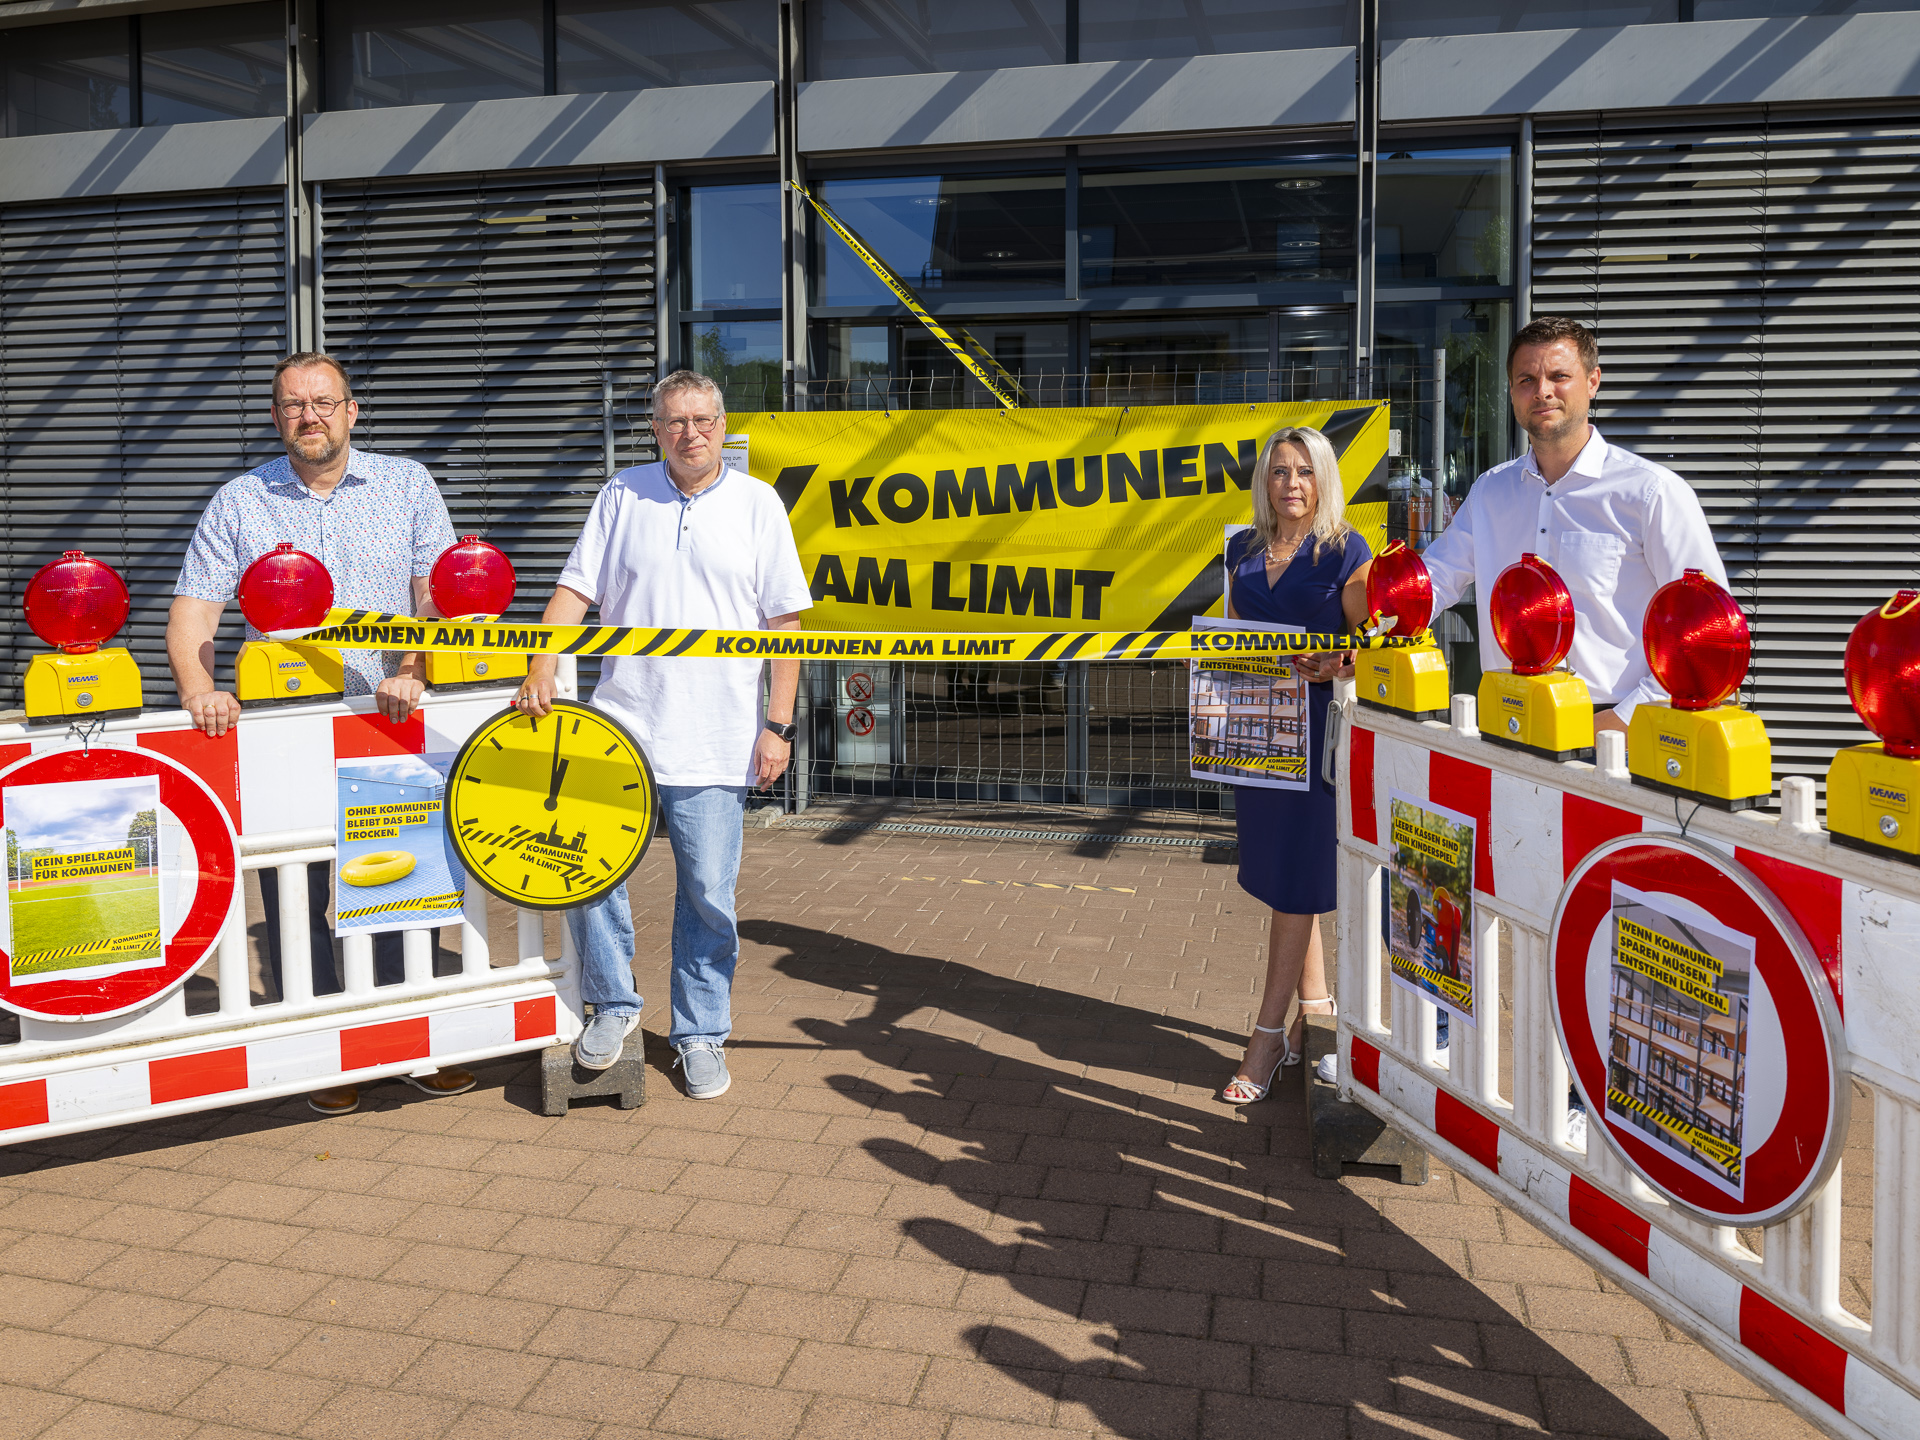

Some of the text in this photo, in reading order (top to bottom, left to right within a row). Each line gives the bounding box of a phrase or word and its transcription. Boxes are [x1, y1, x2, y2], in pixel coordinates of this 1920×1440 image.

[829, 438, 1258, 529] KOMMUNEN
[811, 553, 1115, 621] AM LIMIT
[431, 627, 475, 646] AM
[481, 629, 554, 649] LIMIT
[715, 636, 1016, 655] KOMMUNEN AM LIMIT
[1190, 633, 1370, 651] KOMMUNEN
[1200, 661, 1289, 677] ENTSTEHEN LÜCKEN.
[68, 675, 99, 683] WEMAS
[1659, 733, 1687, 748] WEMAS
[1869, 786, 1906, 803] WEMAS
[347, 801, 440, 816] OHNE KOMMUNEN
[347, 814, 426, 828] BLEIBT DAS BAD
[347, 828, 398, 840] TROCKEN.
[1395, 818, 1459, 852] LEERE KASSEN SIND
[525, 844, 584, 862] KOMMUNEN
[1395, 831, 1456, 865] KEIN KINDERSPIEL.
[34, 850, 133, 867] KEIN SPIELRAUM
[519, 852, 562, 872] AM LIMIT
[35, 862, 133, 880] FÜR KOMMUNEN
[424, 892, 459, 903] KOMMUNEN
[113, 932, 153, 944] KOMMUNEN
[1620, 919, 1721, 974] WENN KOMMUNEN
[1620, 935, 1710, 987] SPAREN MÜSSEN,
[1620, 951, 1727, 1011] ENTSTEHEN LÜCKEN.
[1691, 1138, 1721, 1160] AM LIMIT
[1694, 1130, 1734, 1154] KOMMUNEN
